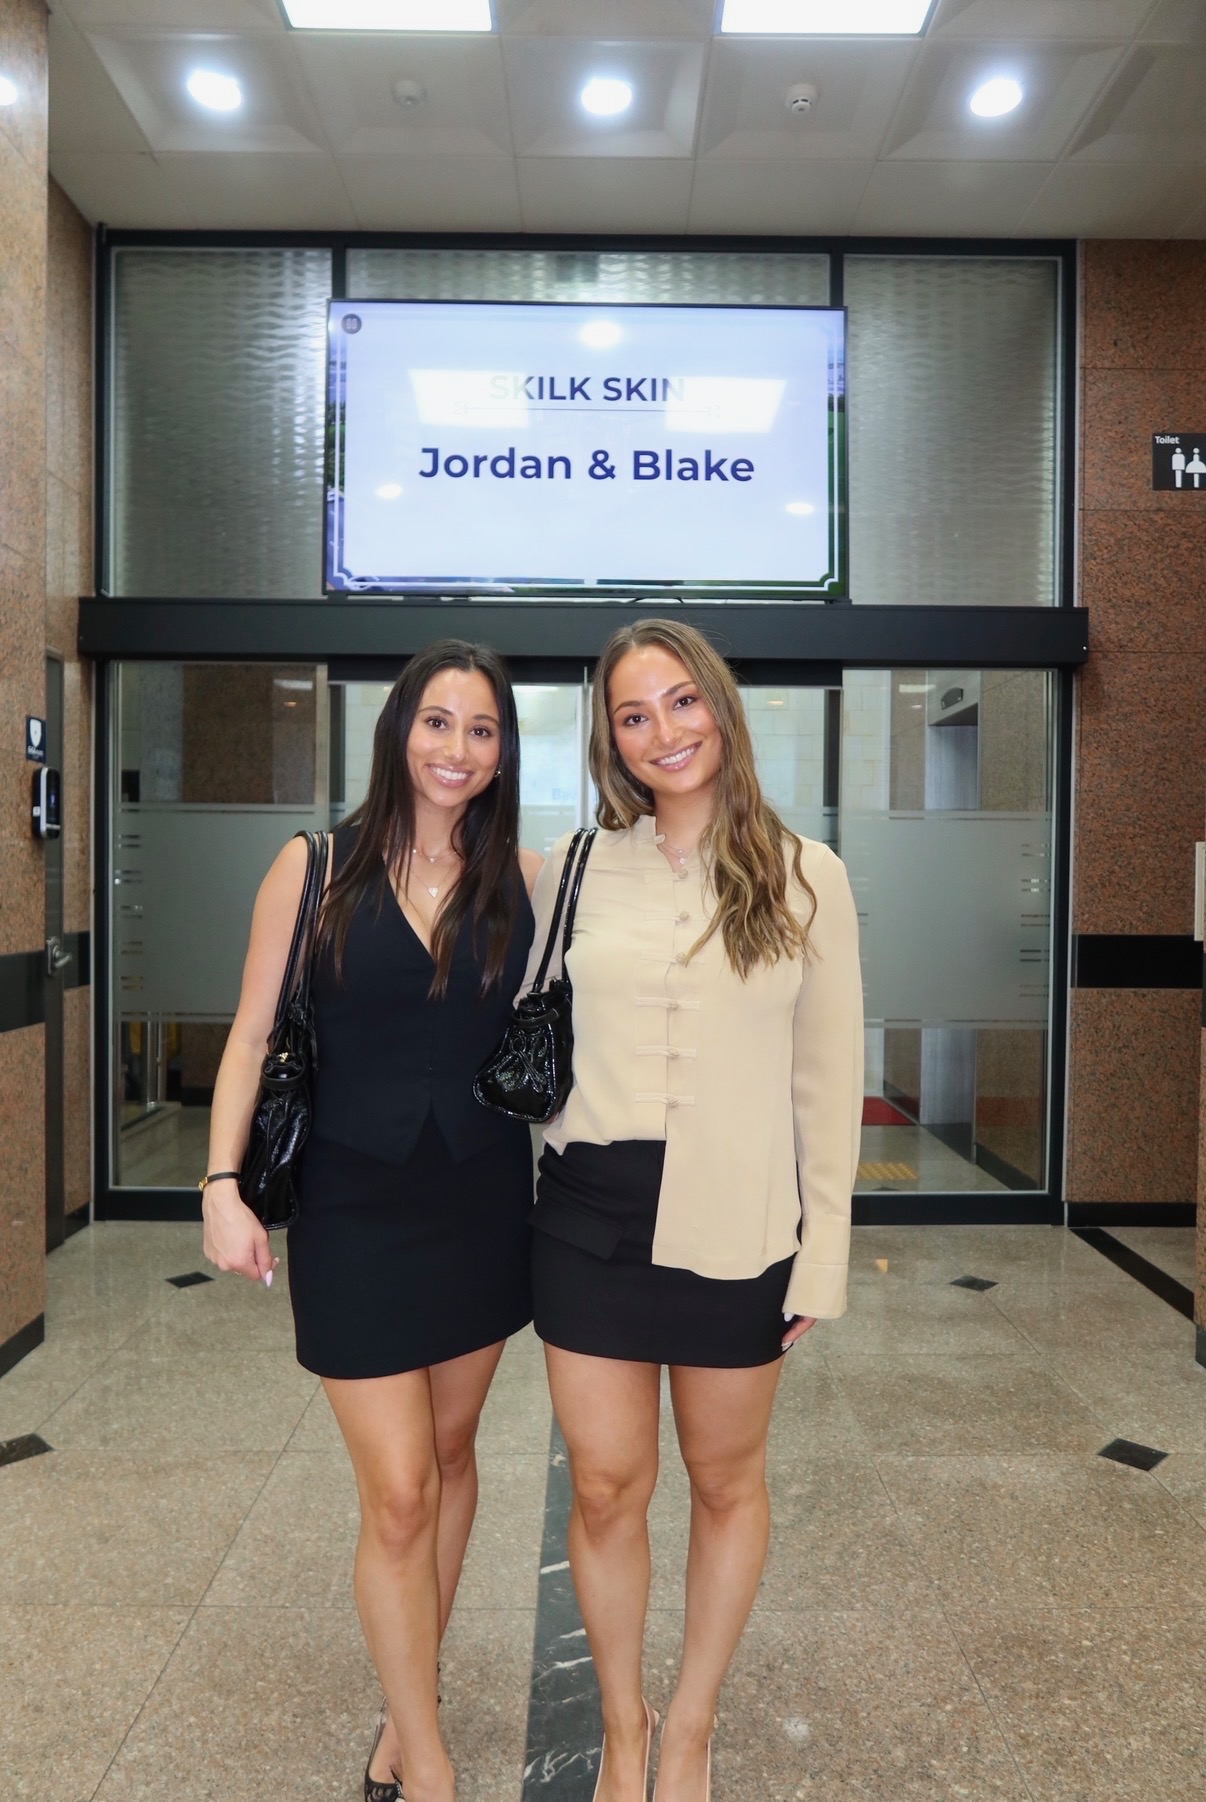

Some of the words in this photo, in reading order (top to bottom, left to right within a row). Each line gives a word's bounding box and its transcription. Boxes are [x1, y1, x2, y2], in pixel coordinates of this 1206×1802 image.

[490, 375, 592, 400] SKILK
[603, 377, 684, 402] SKIN
[1154, 435, 1180, 444] Toilet
[419, 447, 572, 480] Jordan
[588, 449, 616, 480] &
[633, 449, 755, 482] Blake
